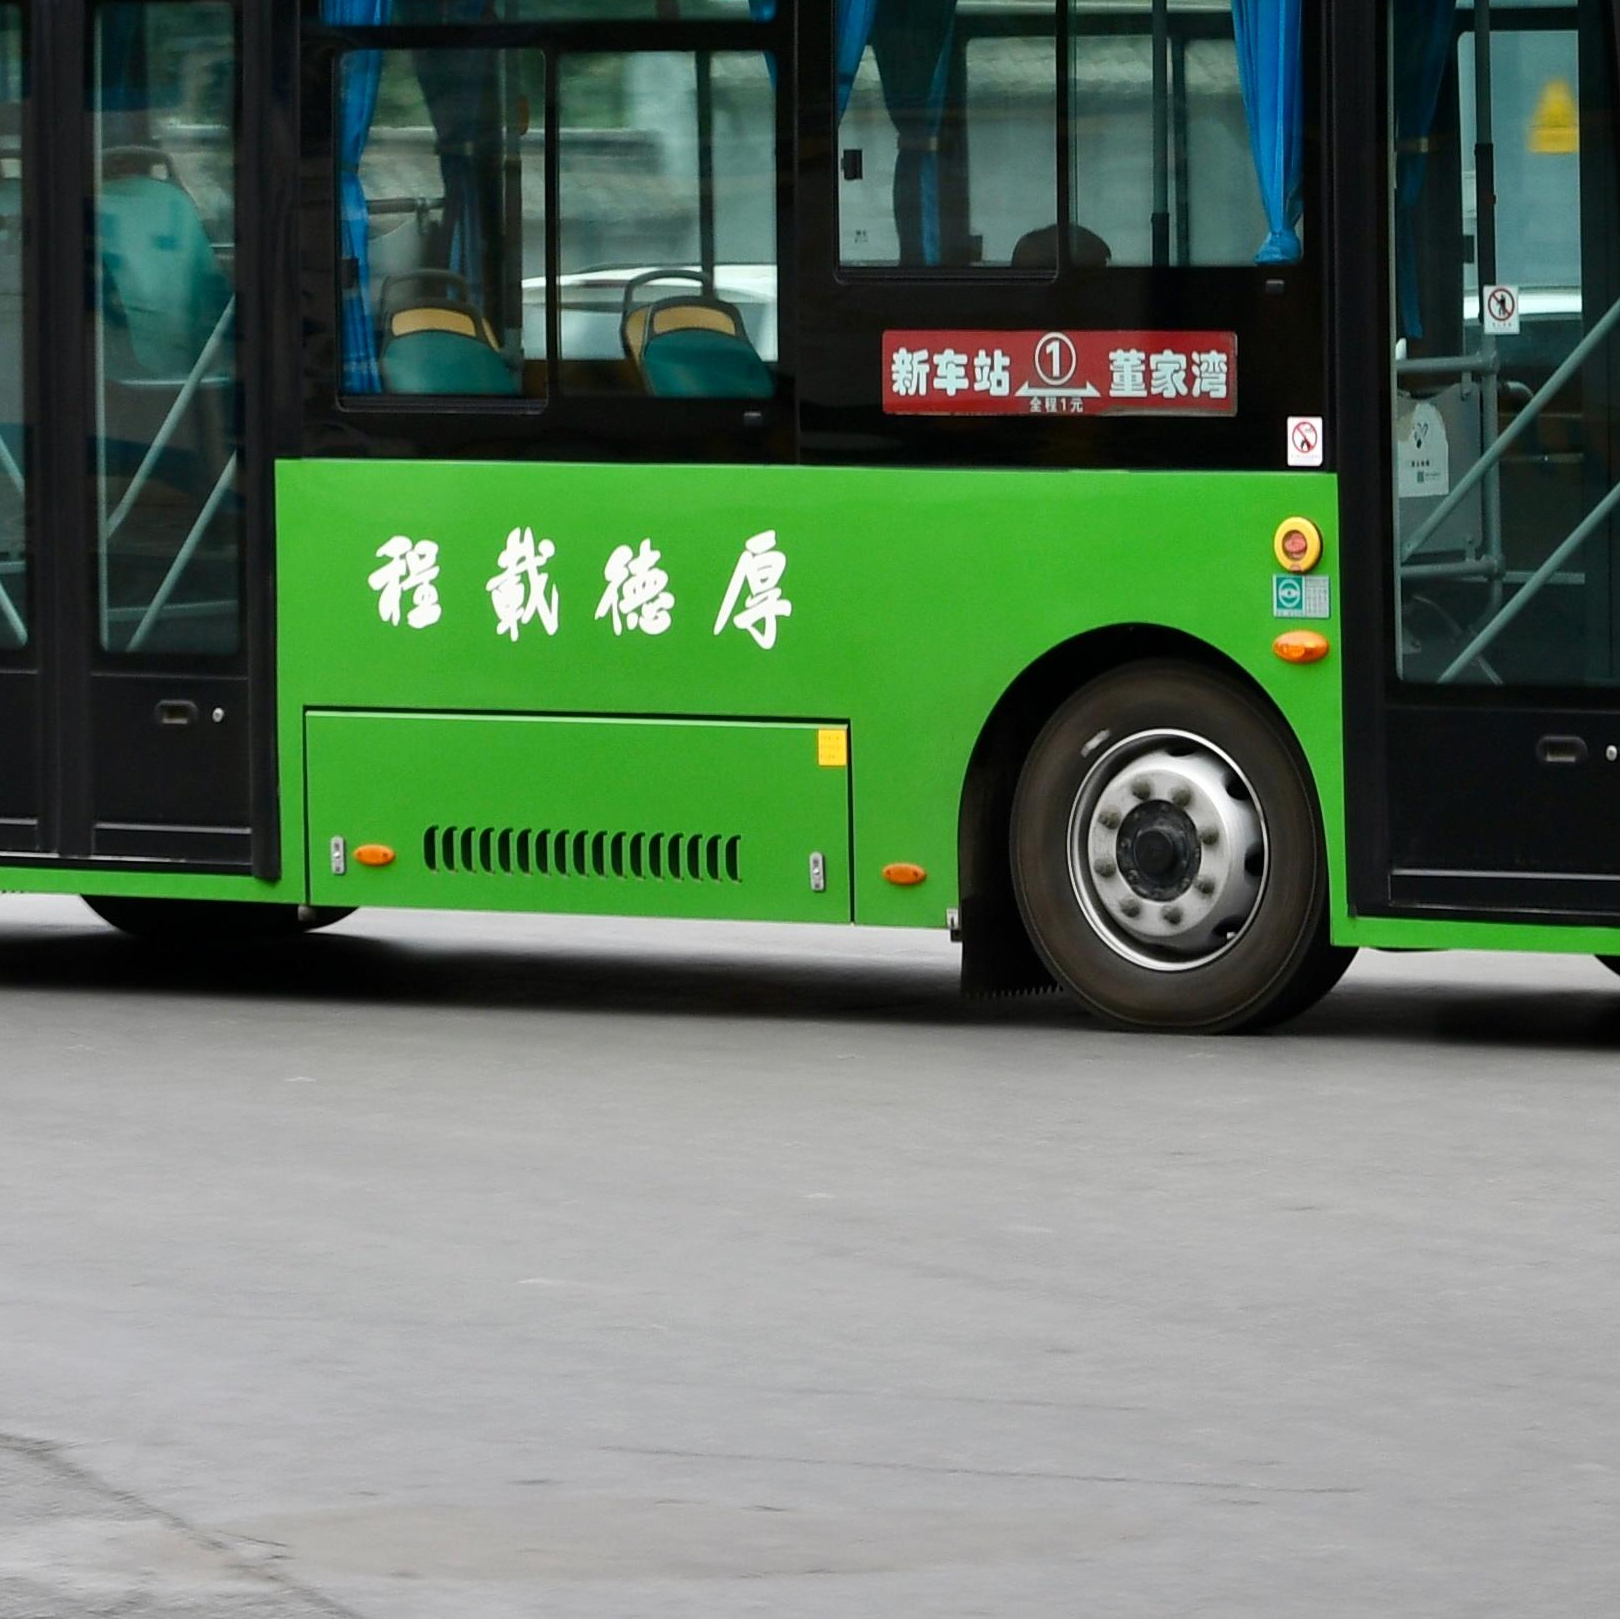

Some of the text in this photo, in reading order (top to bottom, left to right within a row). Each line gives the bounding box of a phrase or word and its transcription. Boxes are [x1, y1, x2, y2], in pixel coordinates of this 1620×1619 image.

[891, 347, 1228, 399] 新车站 董家湾
